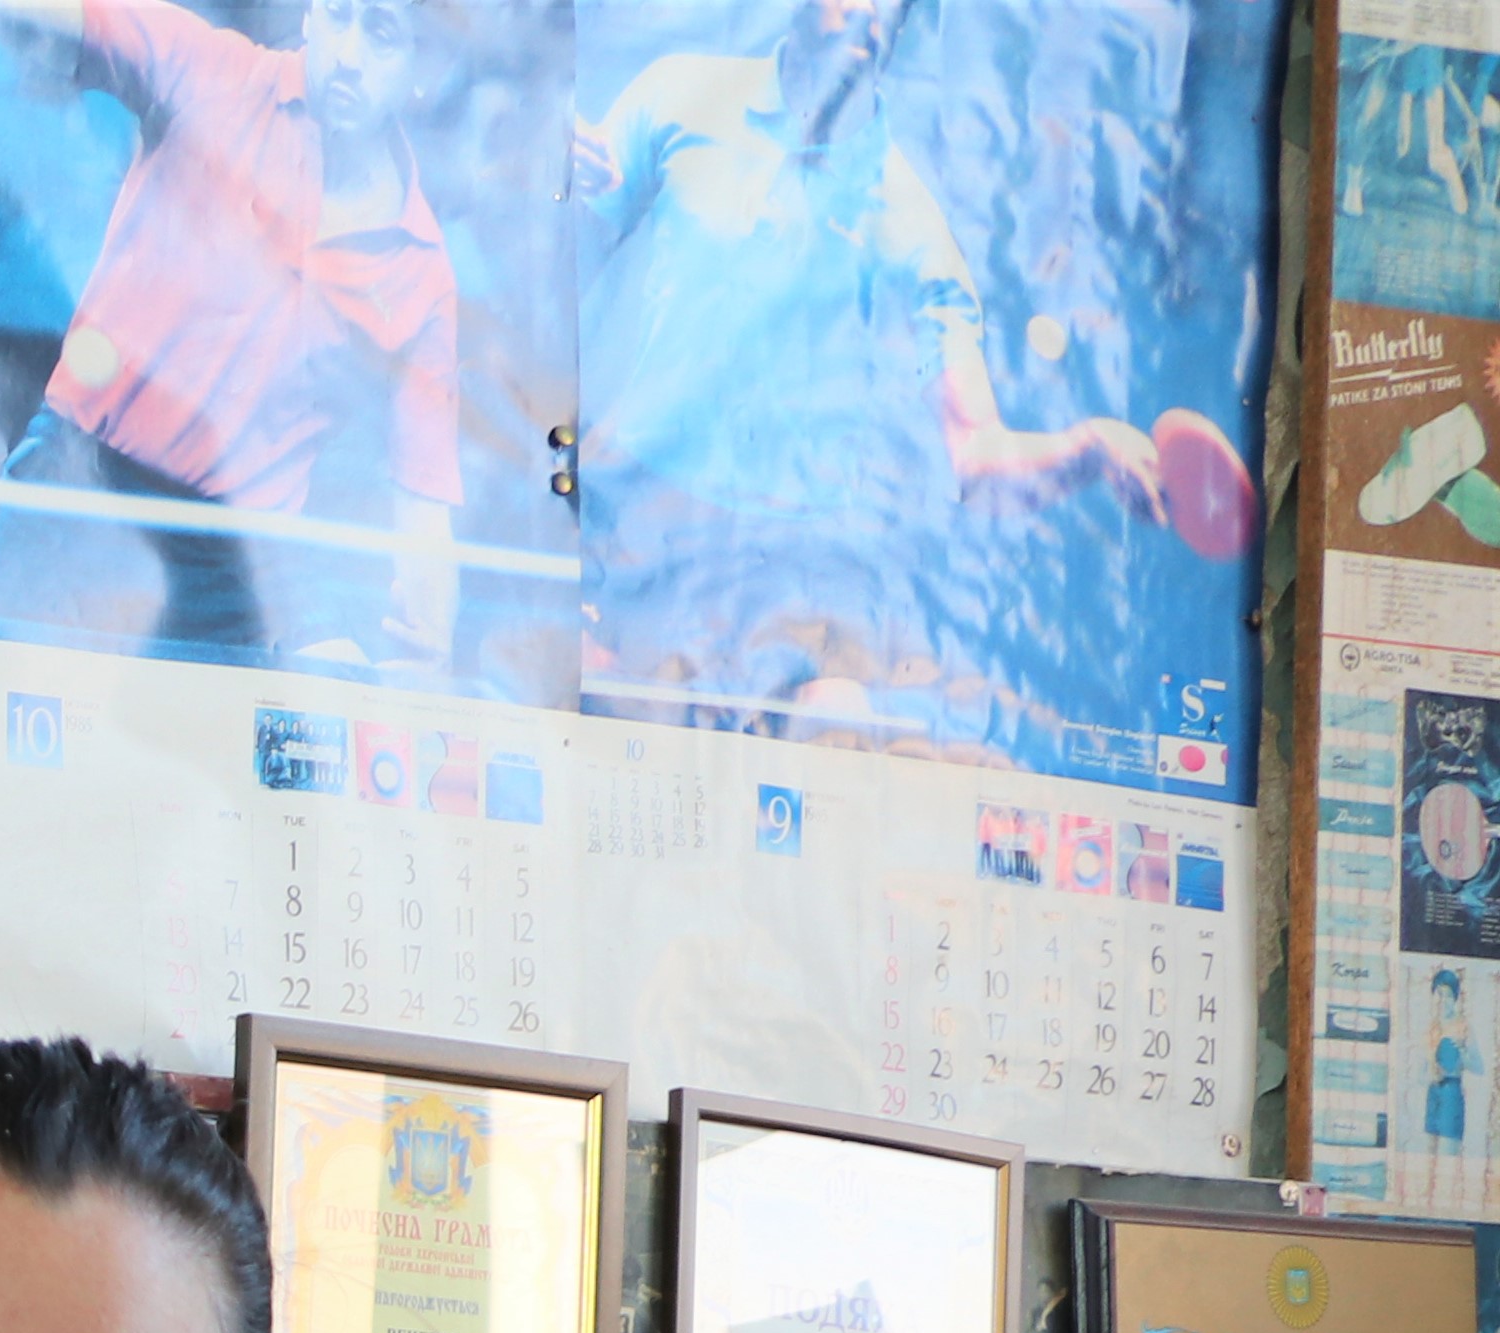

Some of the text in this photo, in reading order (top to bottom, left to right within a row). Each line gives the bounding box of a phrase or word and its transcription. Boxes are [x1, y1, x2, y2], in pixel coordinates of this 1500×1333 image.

[1331, 318, 1443, 368] Butterfly
[1181, 684, 1206, 722] S
[11, 702, 61, 758] 10
[767, 793, 794, 847] 9
[285, 884, 303, 918] 8
[1201, 951, 1216, 983] 7
[1188, 1074, 1216, 1110] 28
